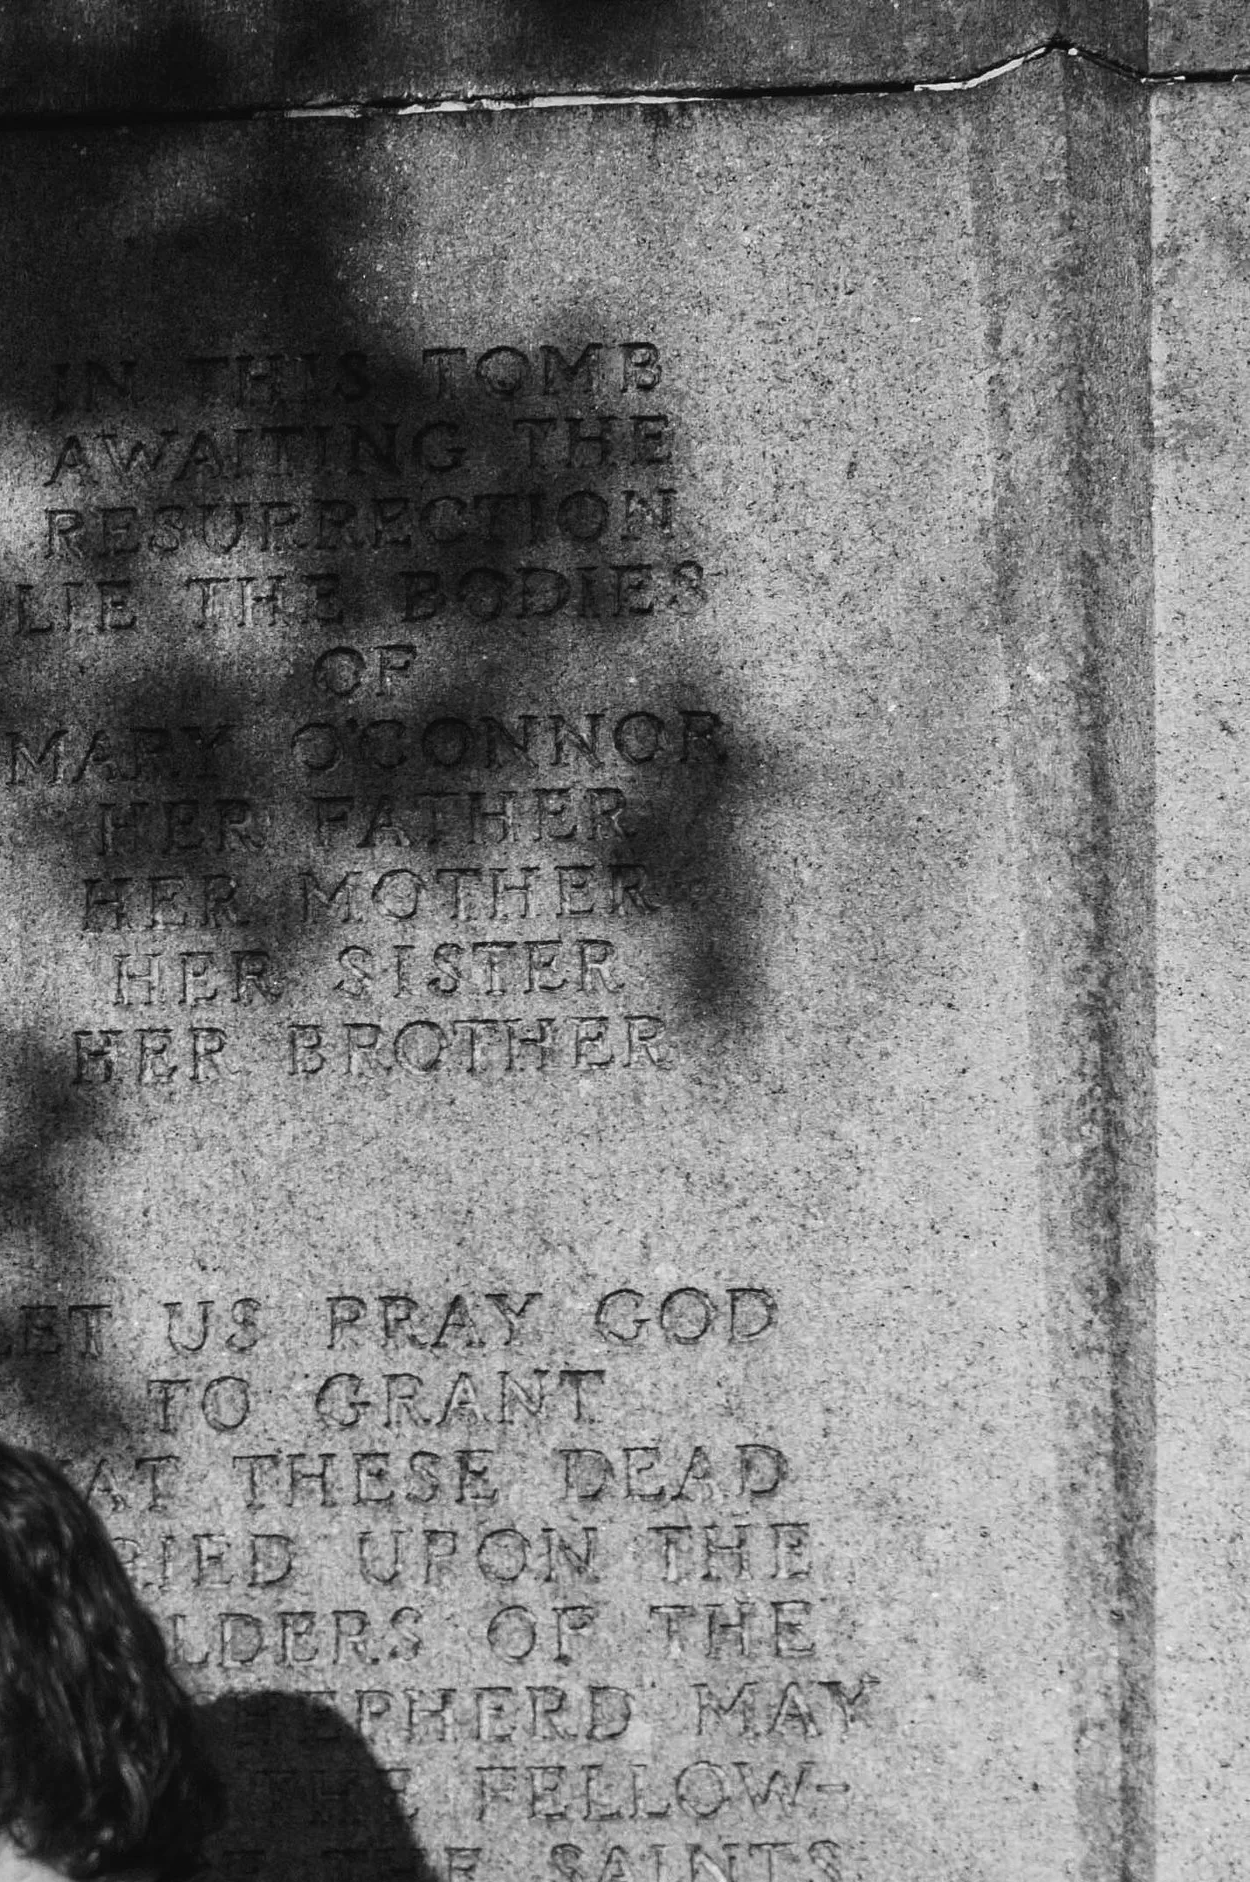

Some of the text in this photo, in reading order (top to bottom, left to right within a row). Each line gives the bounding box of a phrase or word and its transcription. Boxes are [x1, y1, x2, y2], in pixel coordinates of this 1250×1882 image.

[51, 342, 662, 406] IN THIS TOMB
[44, 414, 670, 487] AWAITING THE
[44, 487, 677, 559] RESURRECTION
[15, 559, 709, 636] LIE THE BODIES
[312, 644, 417, 699] OF
[5, 710, 730, 787] MARY O'CONNOR
[96, 787, 640, 857] HER FATHER
[81, 863, 662, 933] HER MOTHER
[113, 938, 626, 1008] HER SISTER
[72, 1014, 671, 1086] HER BROTHER
[163, 1296, 263, 1356] US
[324, 1291, 545, 1351] PRAY
[593, 1286, 780, 1347] GOD
[149, 1368, 607, 1434] TO GRANT
[84, 1443, 791, 1512] AT THESE DEAD
[112, 1521, 813, 1589] RIED UPON THE
[166, 1599, 818, 1668] LDERS OF THE
[692, 1673, 881, 1739] MAY
[474, 1760, 851, 1822] FELLOW-
